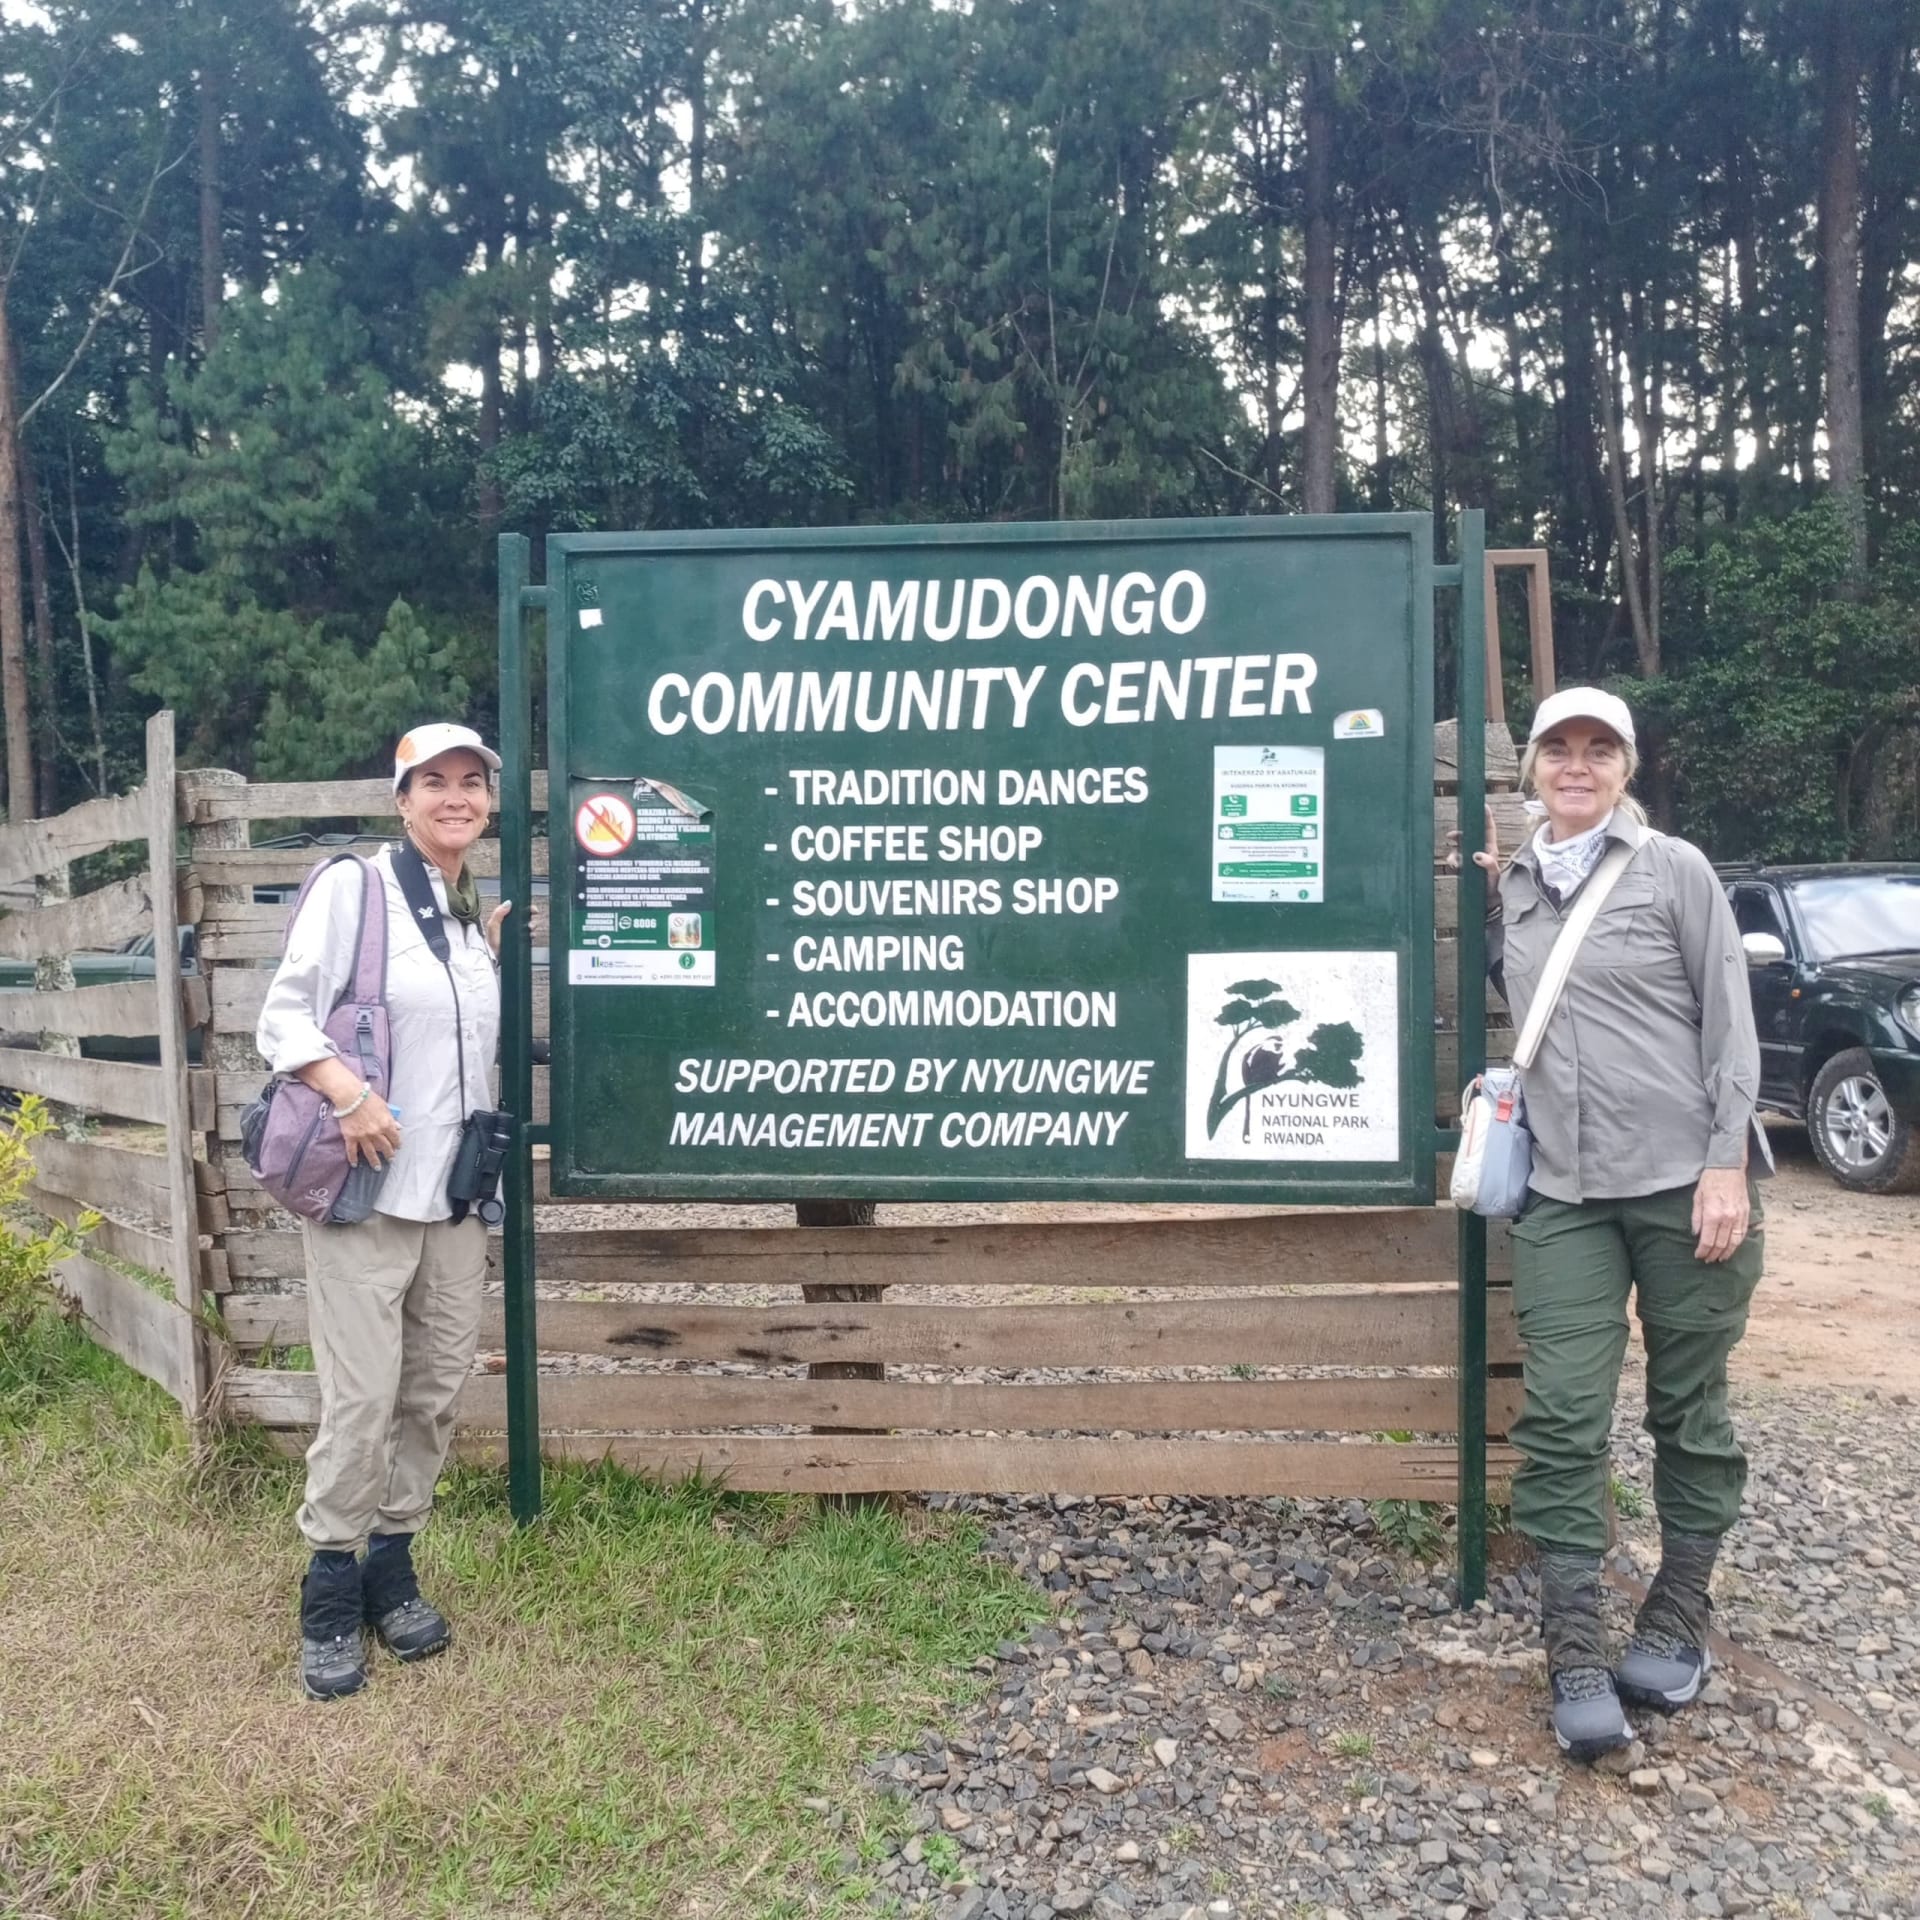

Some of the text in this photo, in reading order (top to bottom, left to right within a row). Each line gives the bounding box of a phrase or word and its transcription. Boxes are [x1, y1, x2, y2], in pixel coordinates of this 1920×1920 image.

[741, 569, 1207, 642] CYAMUDONGO
[647, 652, 1318, 736] COMMUNITY CENTER
[764, 766, 1149, 806] - TRADITION DANCES
[763, 824, 1043, 862] - COFFEE SHOP
[766, 876, 1120, 917] - SOUVENIRS SHOP
[633, 918, 656, 928] 8006
[766, 934, 965, 973] - CAMPING
[786, 989, 1117, 1028] ACCOMMODATION
[674, 1057, 1155, 1095] SUPPORTED BY NYUNGWE
[1261, 1094, 1360, 1108] NYUNGWE
[669, 1111, 1129, 1149] MANAGEMENT COMPANY
[1261, 1114, 1370, 1129] NATIONAL PARK
[1263, 1132, 1325, 1145] RWANDA
